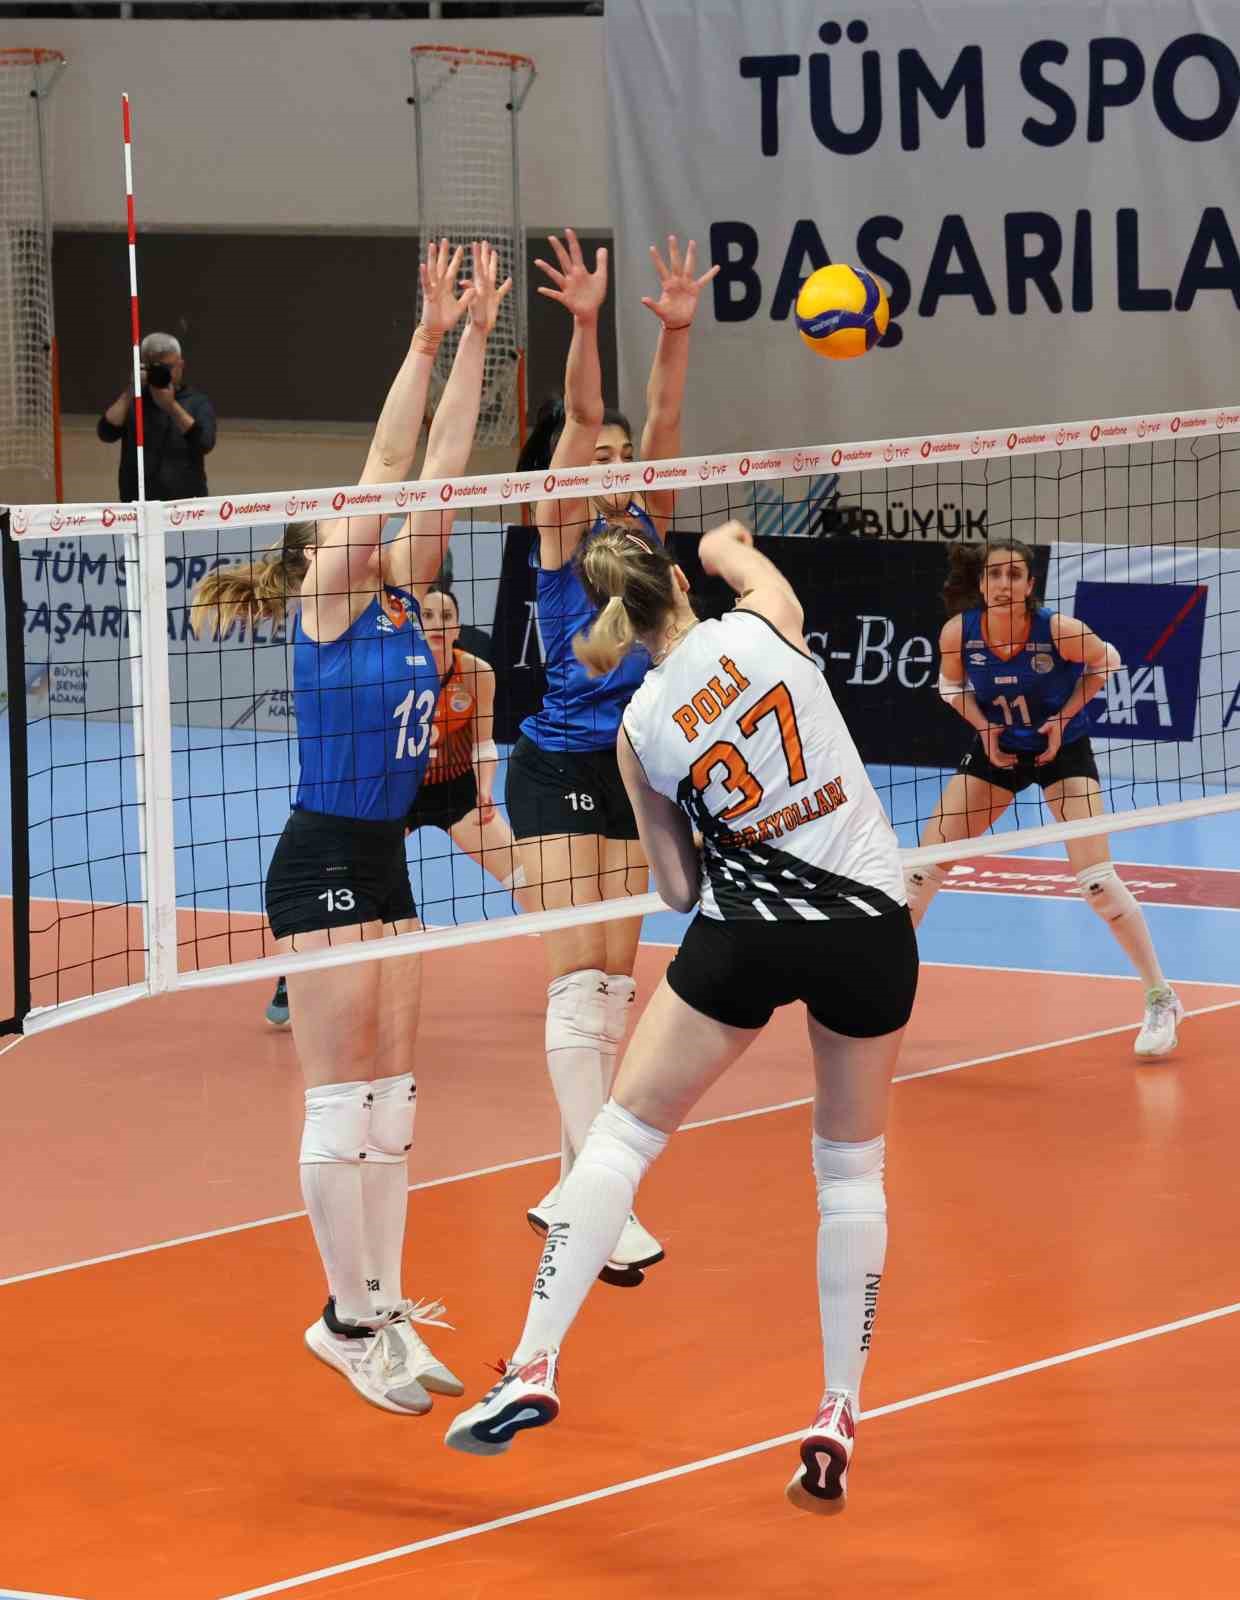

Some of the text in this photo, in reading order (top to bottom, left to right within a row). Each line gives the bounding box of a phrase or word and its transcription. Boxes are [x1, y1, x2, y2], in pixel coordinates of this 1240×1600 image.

[740, 20, 1240, 157] TÜM SPO
[186, 510, 206, 521] TVF
[234, 502, 272, 515] vodafone
[299, 500, 319, 511] TVF
[346, 493, 382, 505] vodafone
[409, 491, 428, 502] TVF
[454, 485, 487, 497] vodafone
[513, 482, 531, 493] TVF
[557, 476, 590, 487] vodafone
[614, 473, 632, 484] TVF
[656, 468, 688, 480] vodafone
[711, 464, 729, 476] TVF
[751, 459, 782, 471] vodafone
[804, 456, 821, 467] TVF
[843, 450, 873, 461] vodafone
[895, 447, 911, 458] TVF
[32, 542, 107, 585] TÜM
[393, 689, 435, 759] 13
[672, 655, 750, 742] POLİ
[992, 695, 1032, 727] 11
[690, 680, 808, 820] 37
[564, 793, 595, 811] 18
[318, 889, 355, 912] 13
[533, 1222, 570, 1300] NineSet
